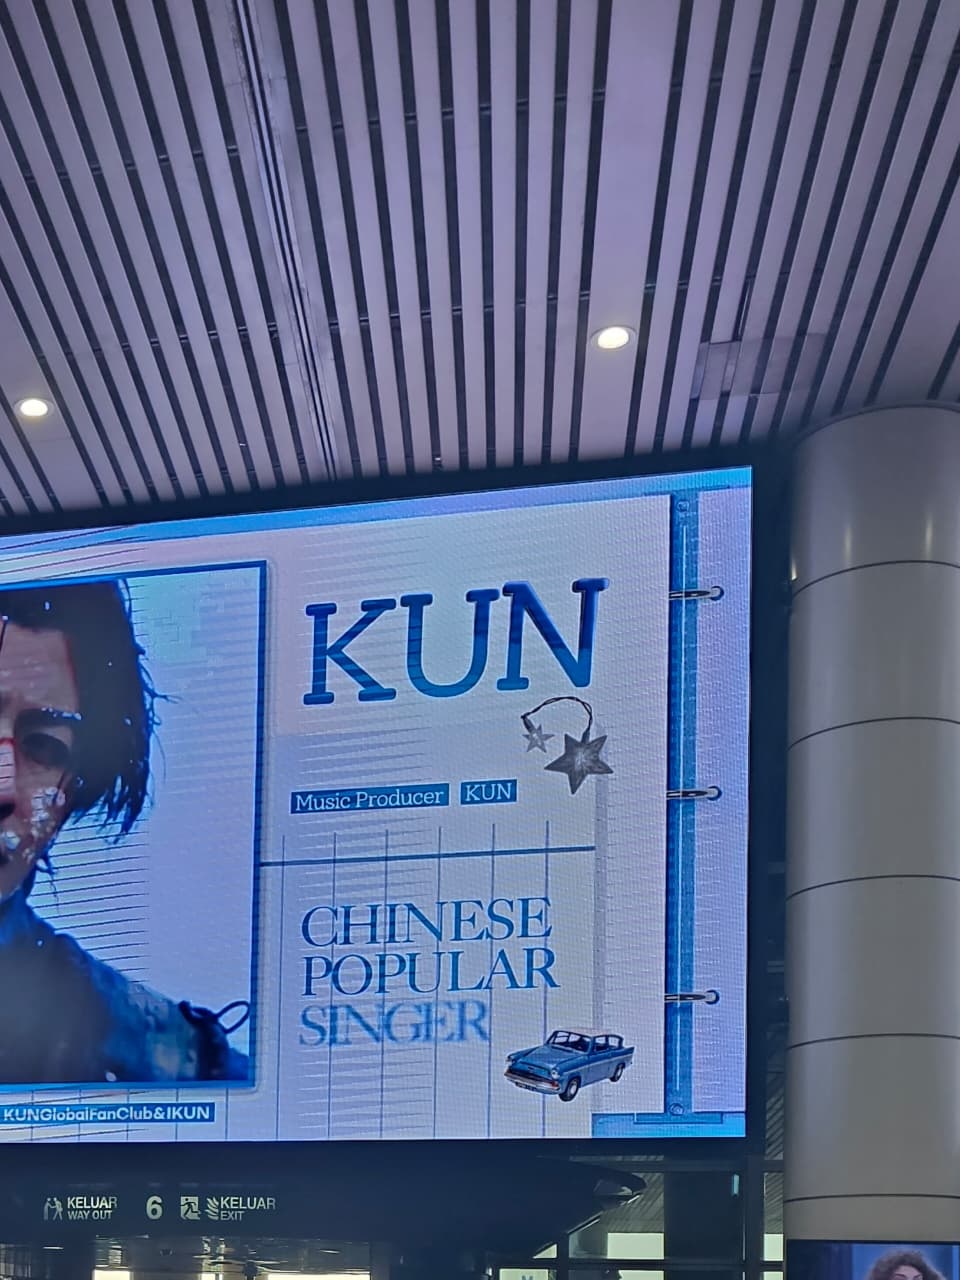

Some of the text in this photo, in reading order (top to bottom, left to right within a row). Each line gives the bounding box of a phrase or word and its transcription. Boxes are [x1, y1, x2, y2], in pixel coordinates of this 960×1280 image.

[303, 577, 610, 705] KUN
[295, 782, 513, 812] Music Producer KUN
[301, 896, 552, 947] CHINESE
[301, 947, 560, 996] POPULAR
[299, 1000, 491, 1046] SINGER
[67, 1196, 117, 1209] KELUAR
[68, 1210, 113, 1220] WAY OUT
[146, 1195, 163, 1220] 6
[221, 1196, 276, 1210] KELUAR
[221, 1211, 244, 1221] EXIT
